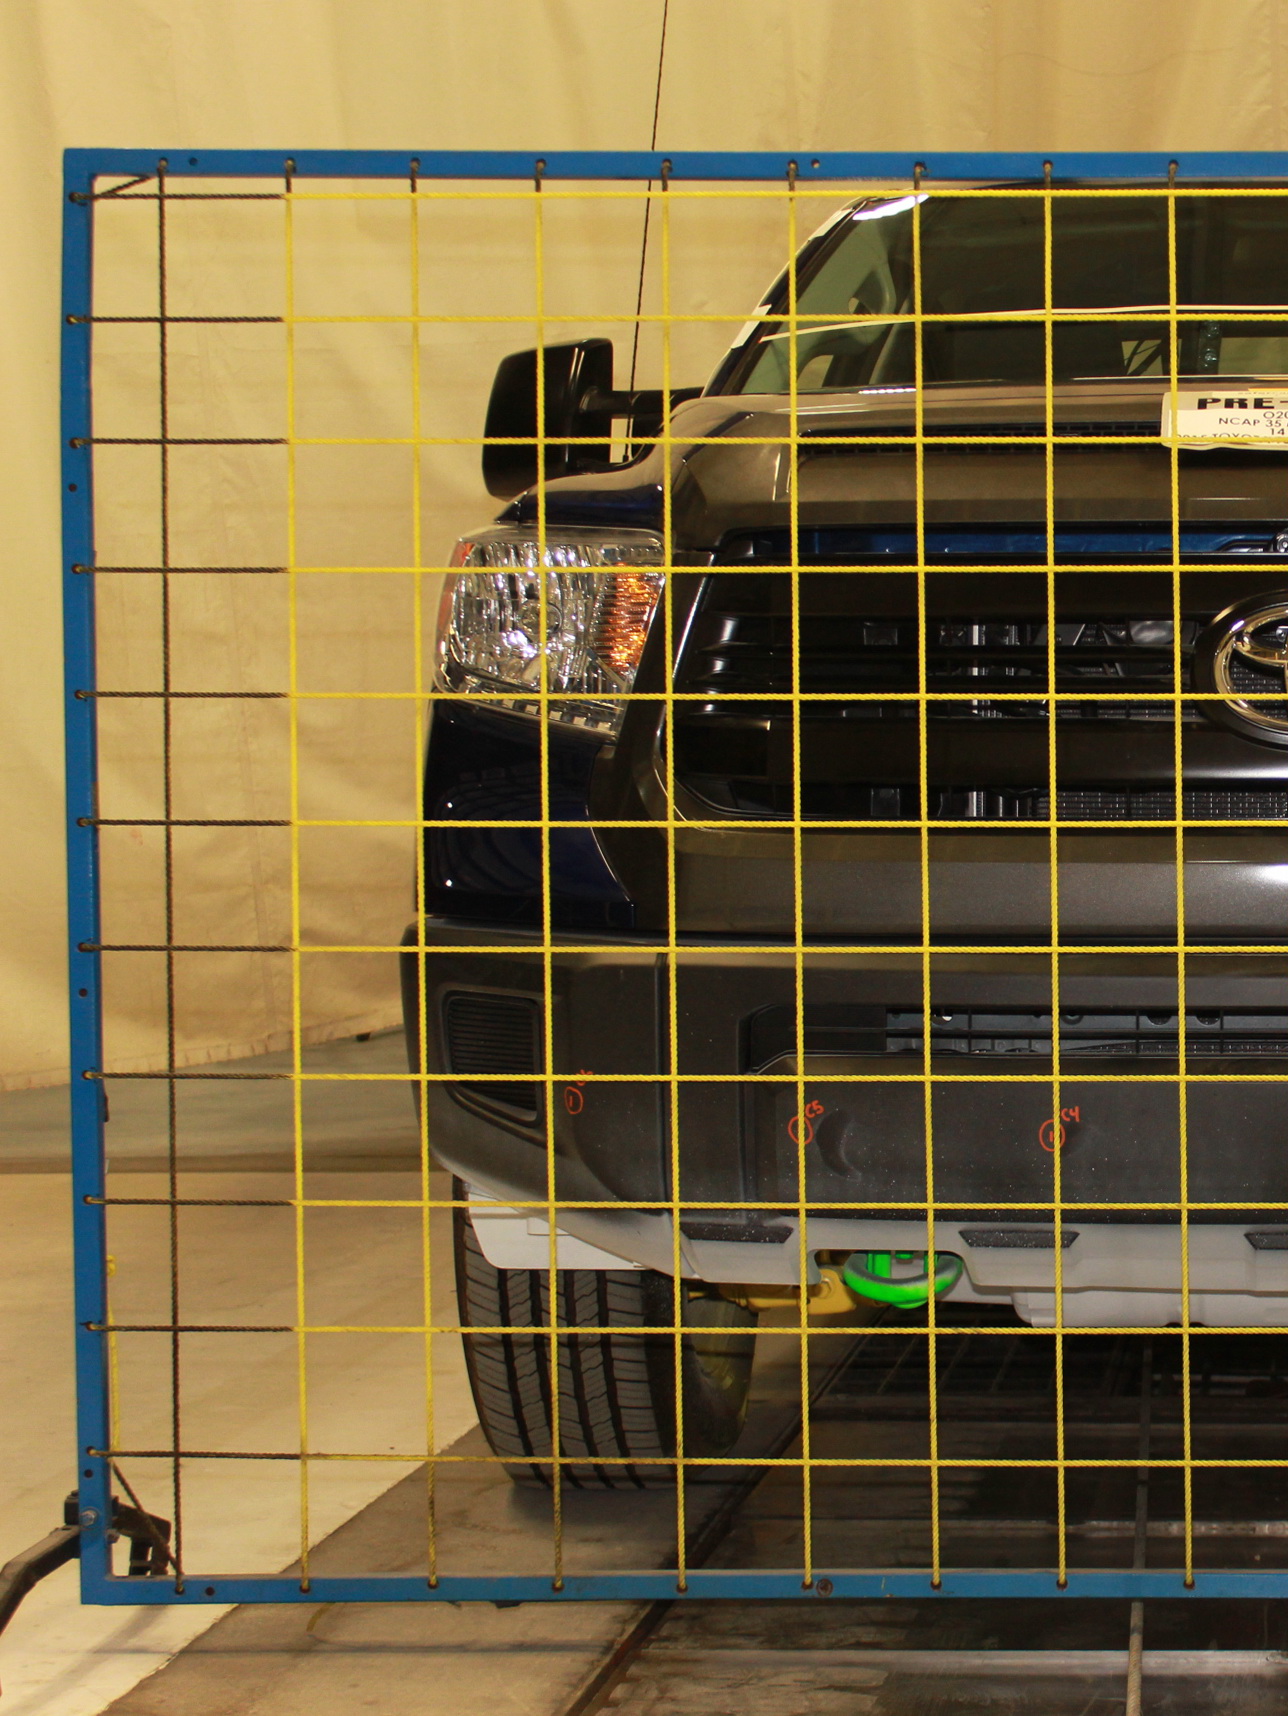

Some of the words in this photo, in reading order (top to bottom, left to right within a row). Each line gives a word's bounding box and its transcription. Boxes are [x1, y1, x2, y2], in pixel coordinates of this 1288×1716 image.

[1217, 417, 1261, 426] NCAP
[1265, 419, 1282, 428] 35
[804, 1099, 825, 1119] C5
[1060, 1105, 1081, 1123] C4
